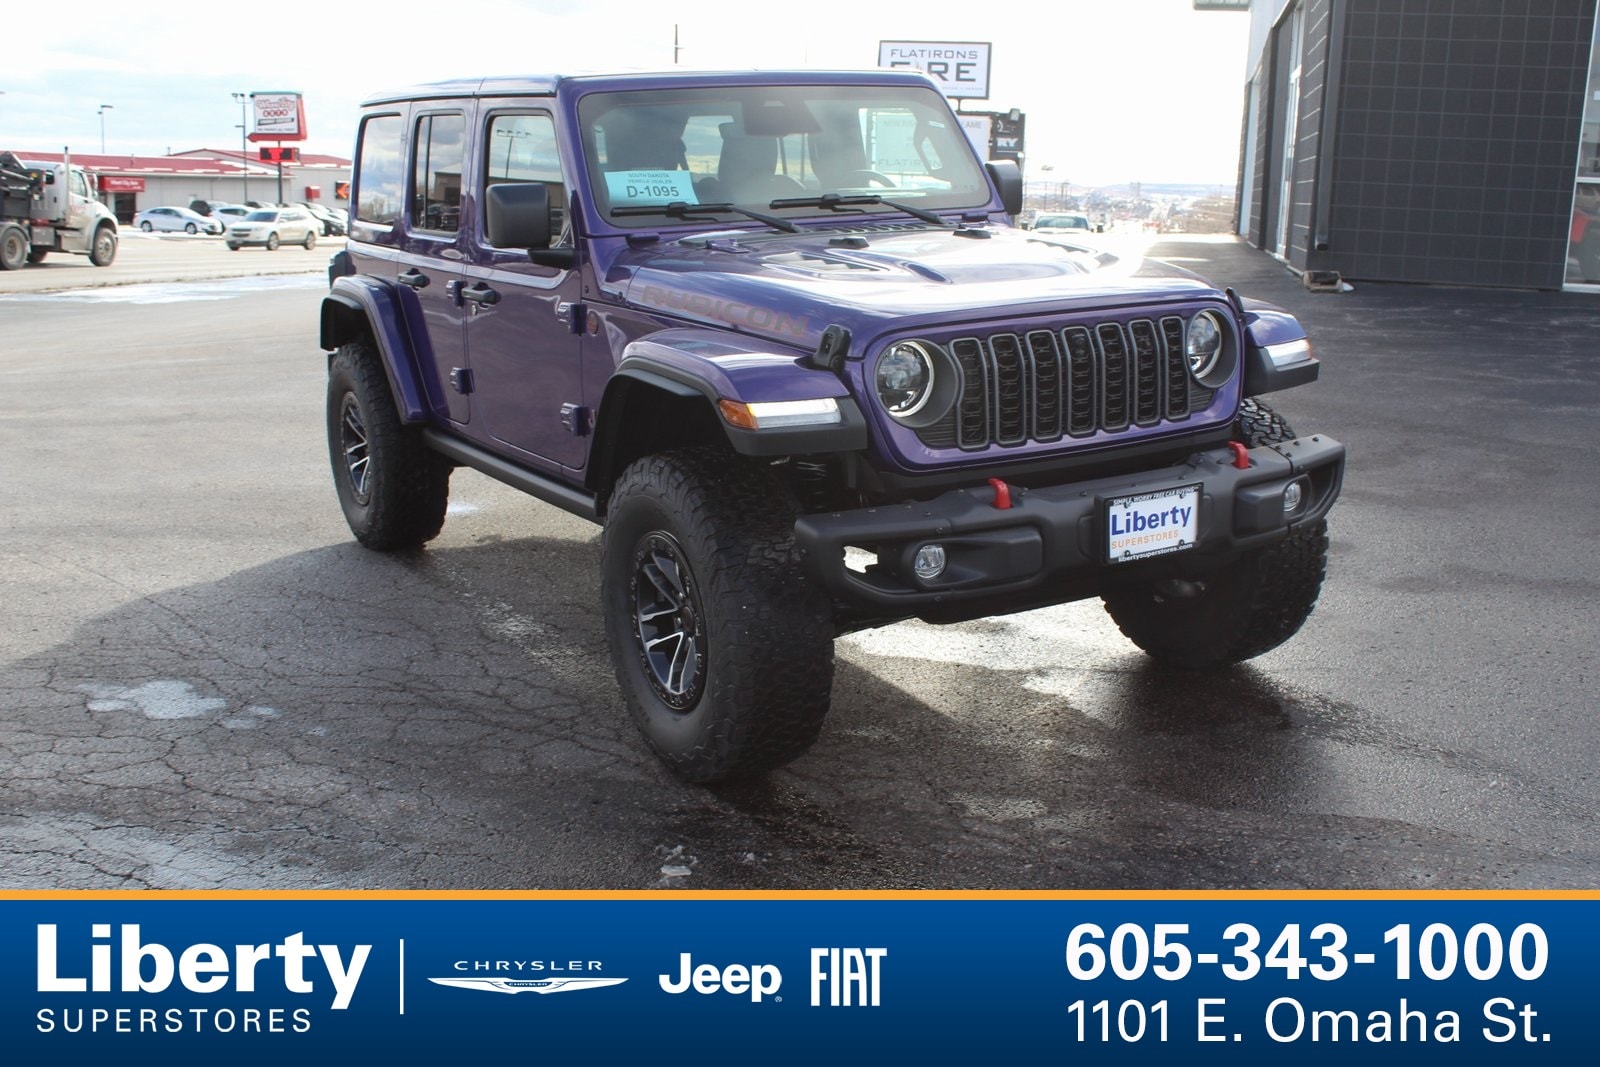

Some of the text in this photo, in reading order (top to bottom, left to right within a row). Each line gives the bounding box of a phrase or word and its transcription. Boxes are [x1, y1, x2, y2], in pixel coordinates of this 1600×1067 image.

[890, 48, 978, 60] FLATIRONS
[890, 61, 977, 82] RE
[626, 186, 679, 198] D-1095
[641, 286, 809, 336] RUBICON
[1111, 506, 1192, 535] Liberty
[1111, 529, 1179, 549] SUPERSTORES
[1118, 543, 1193, 562] libertysuperstores.com
